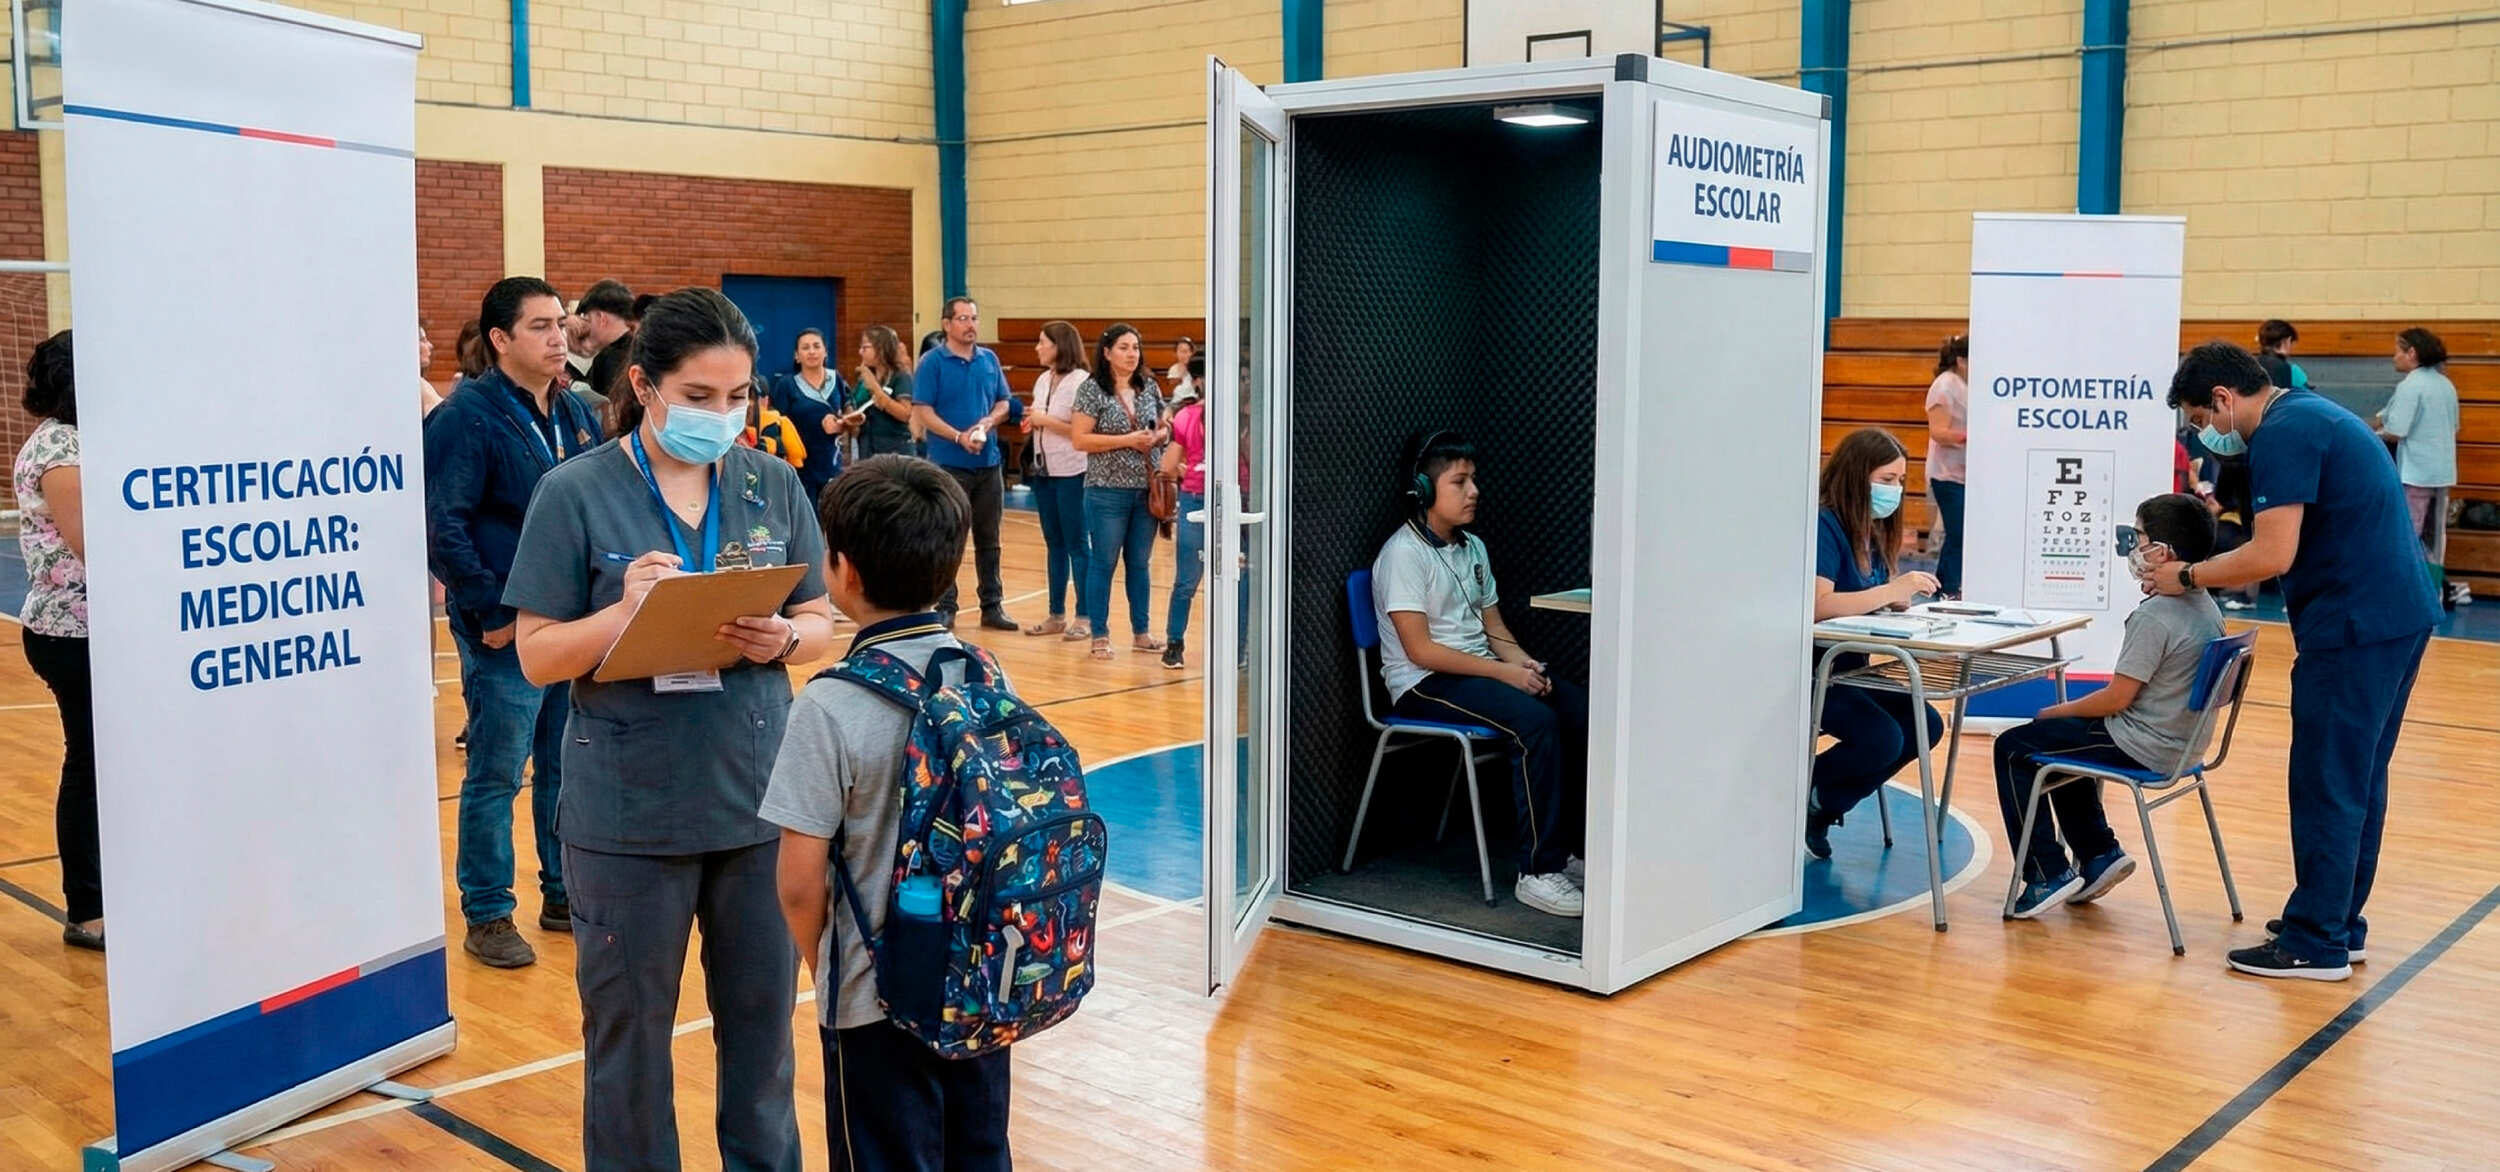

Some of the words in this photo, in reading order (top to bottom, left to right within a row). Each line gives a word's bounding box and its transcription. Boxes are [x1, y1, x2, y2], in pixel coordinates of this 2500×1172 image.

[1667, 133, 1806, 185] AUDIOMETRÍA
[1694, 182, 1782, 224] ESCOLAR
[1992, 374, 2154, 401] OPTOMETRÍA
[2017, 407, 2129, 431] ESCOLAR
[122, 446, 404, 511] CERTIFICACIÓN
[2055, 457, 2082, 485] E
[182, 514, 360, 570] ESCOLAR:
[180, 570, 365, 632] MEDICINA
[190, 628, 362, 691] GENERAL
